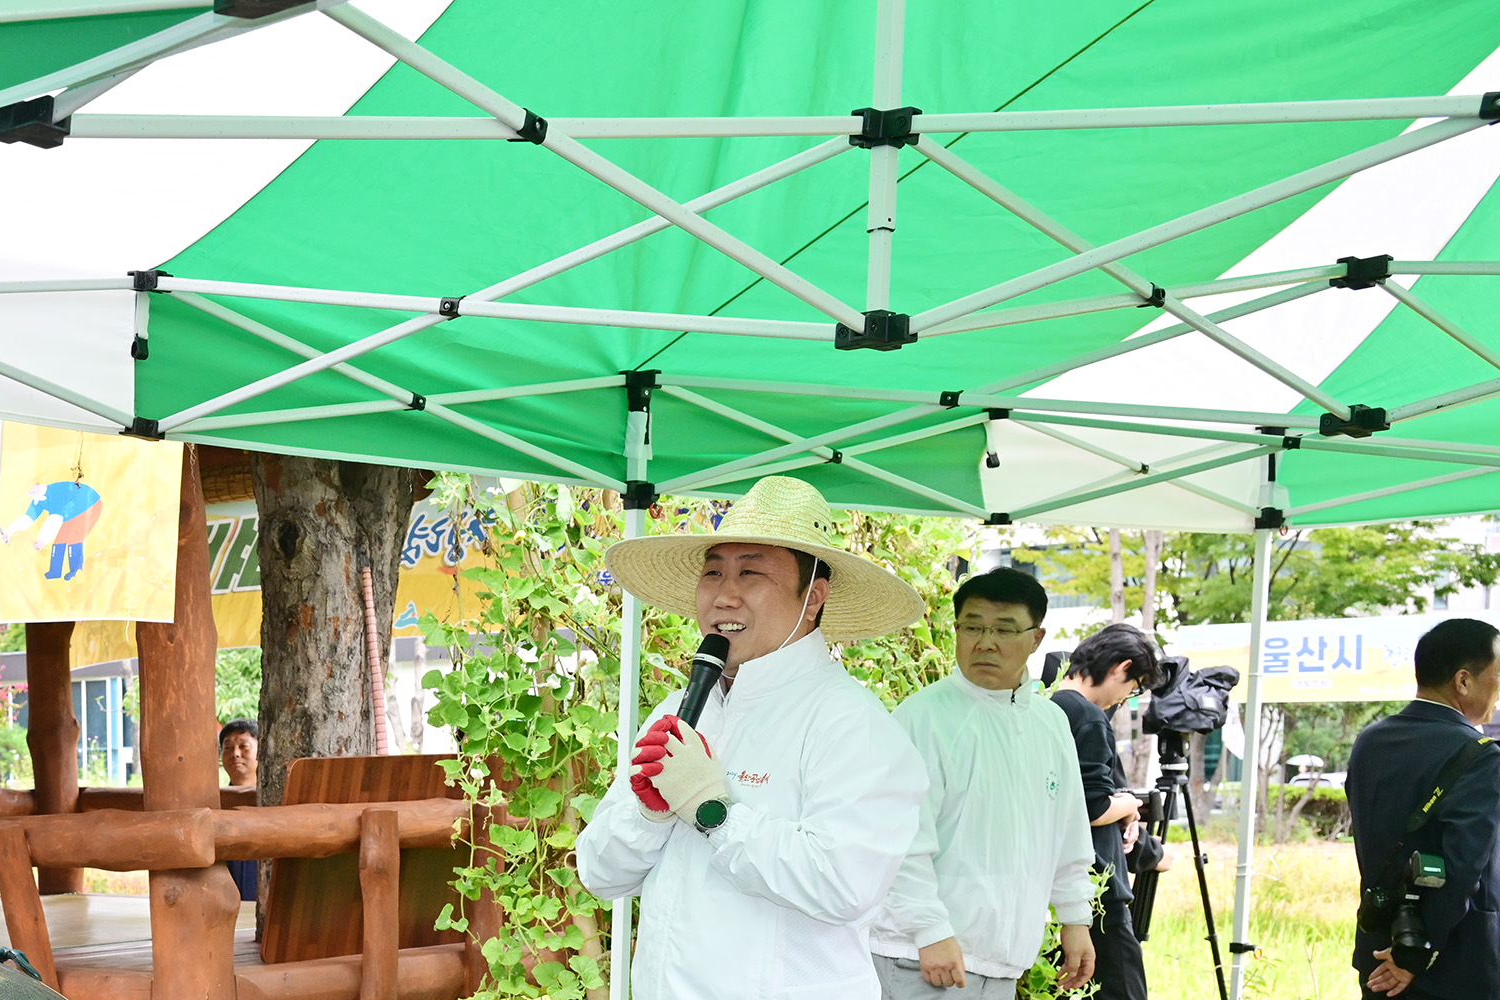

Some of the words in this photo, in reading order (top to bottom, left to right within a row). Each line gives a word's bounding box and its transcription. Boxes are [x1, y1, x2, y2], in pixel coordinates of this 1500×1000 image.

[1262, 634, 1363, 674] 울산시
[1422, 795, 1438, 813] Nikon
[1432, 786, 1444, 798] Z
